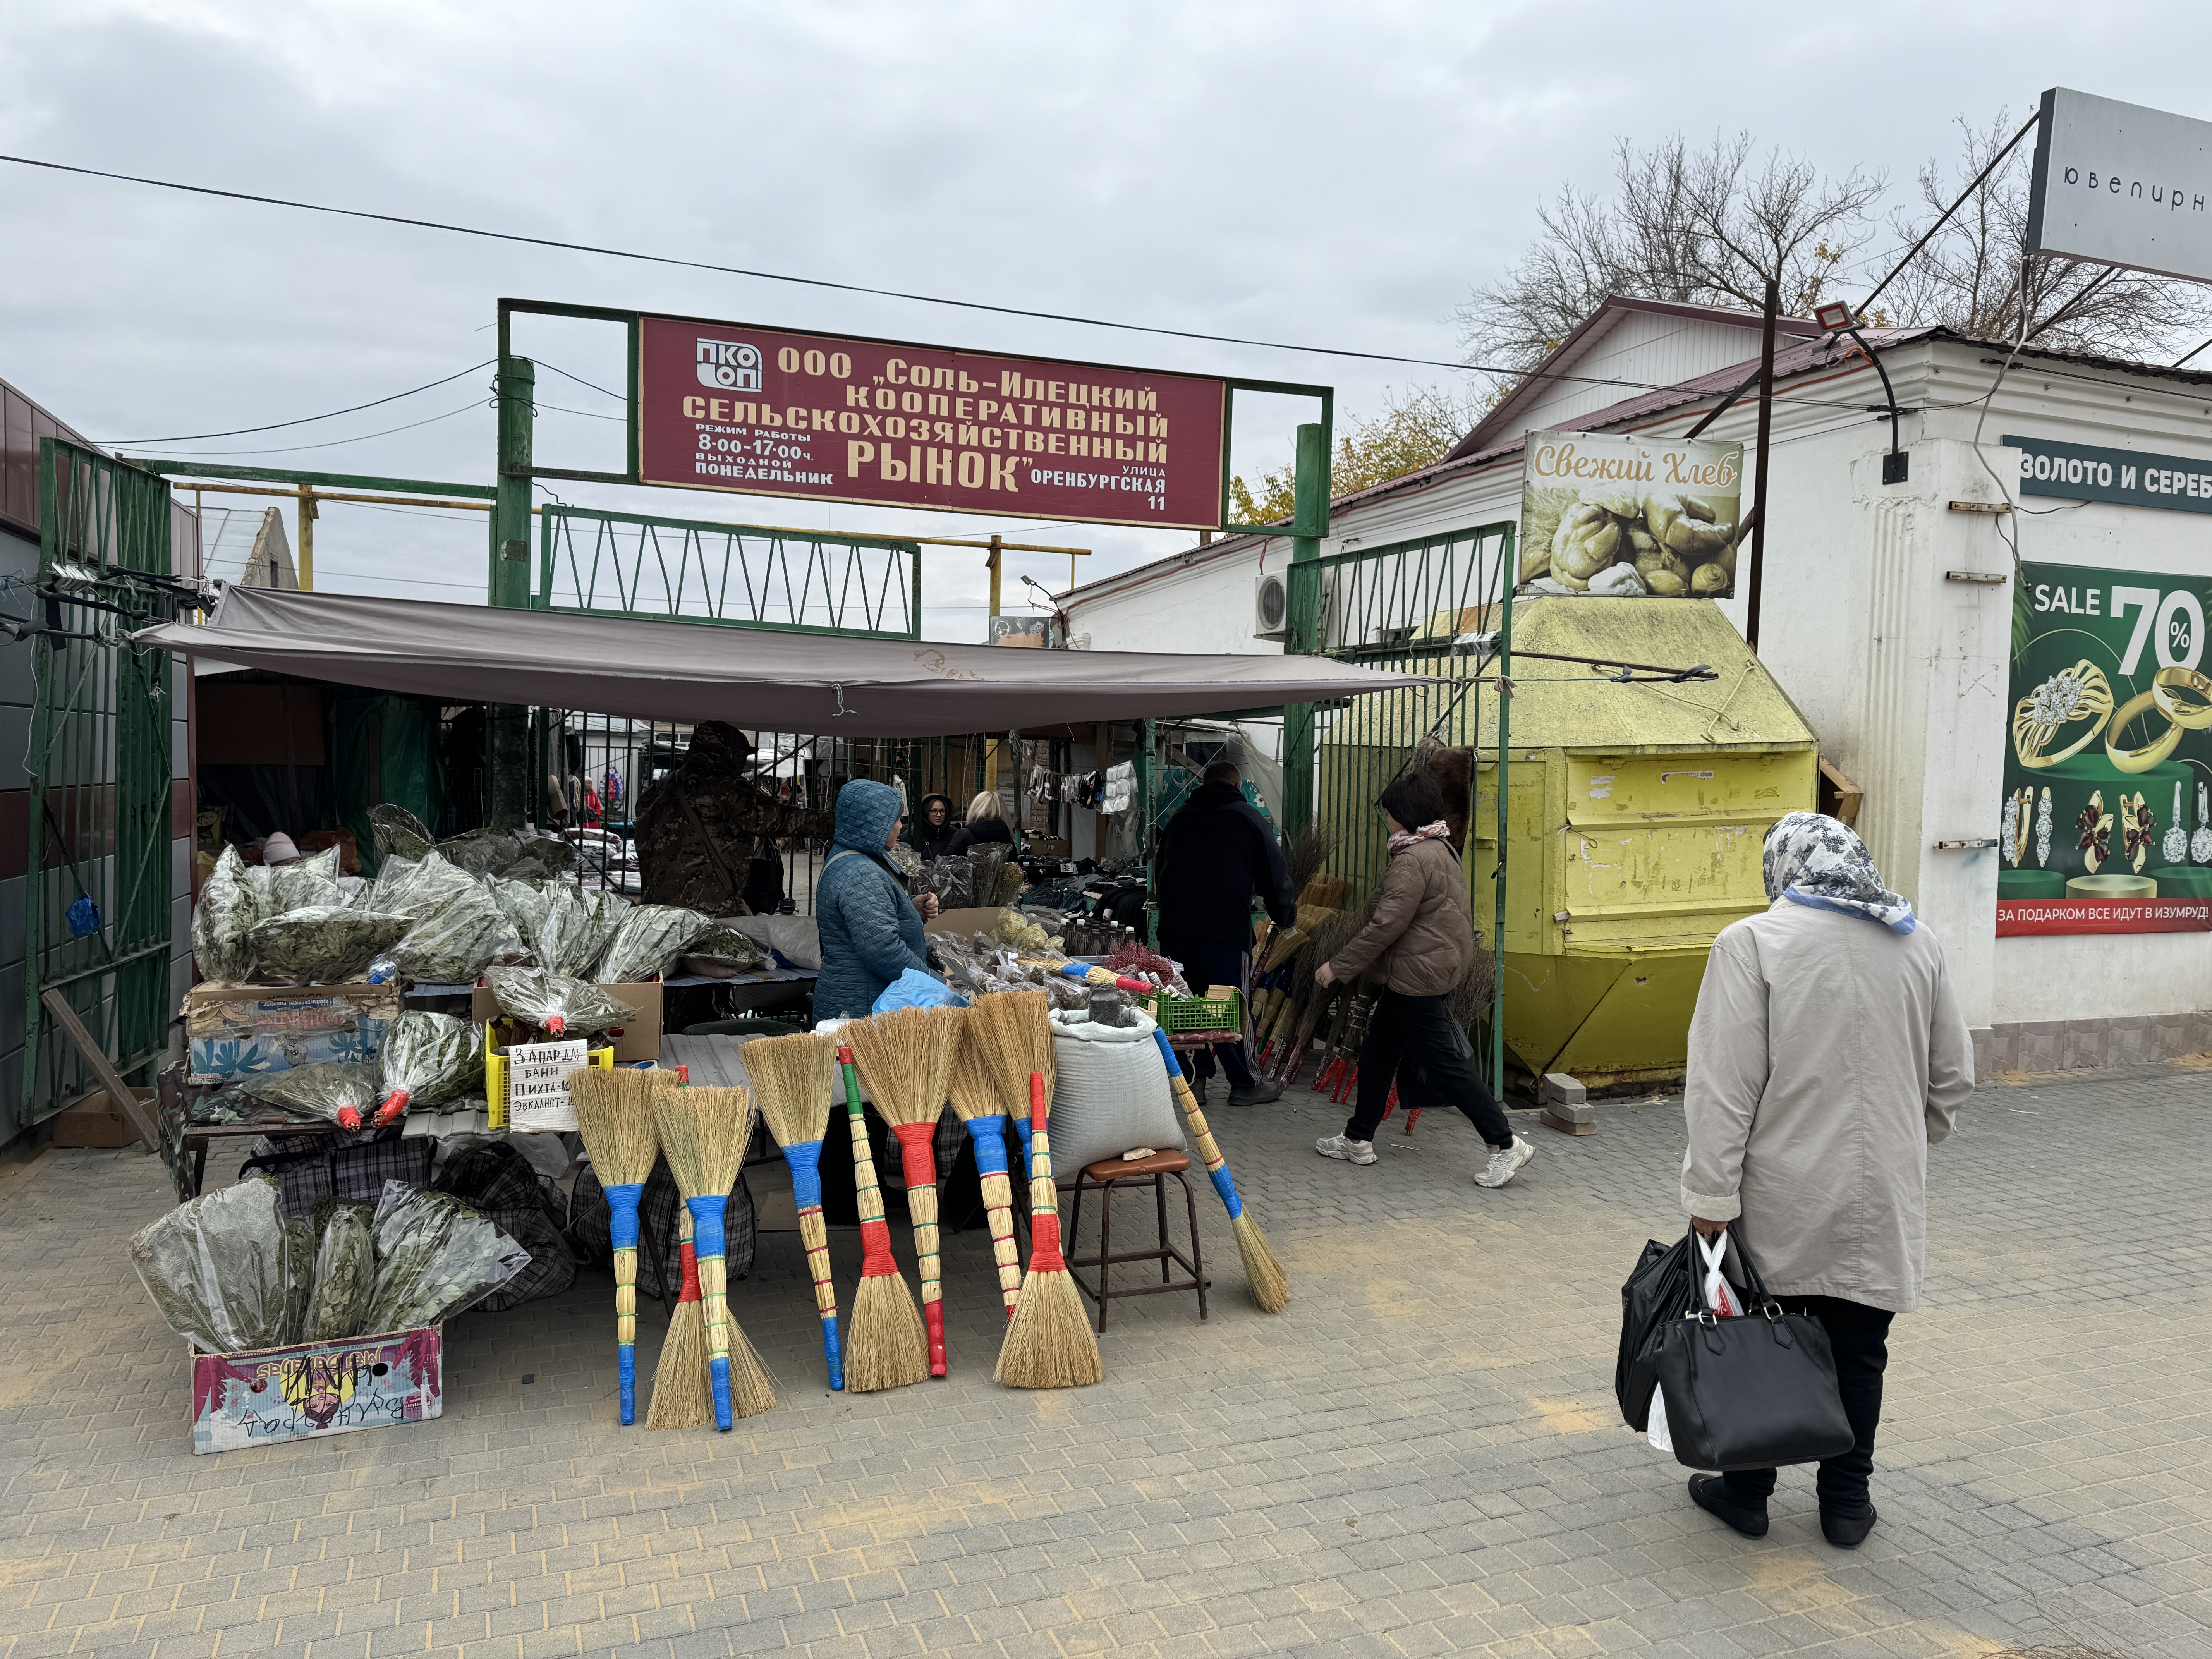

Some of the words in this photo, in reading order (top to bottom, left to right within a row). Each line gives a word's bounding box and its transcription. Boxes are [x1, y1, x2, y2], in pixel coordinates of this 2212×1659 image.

[778, 347, 851, 378] ООО
[847, 385, 1168, 438] КООПЕРАТИВНЫЙ
[683, 396, 1167, 464] СЕЛЬСКОХОЗЯЙСТВЕННЫЙ
[696, 423, 747, 435] РЕЖИМ
[754, 429, 811, 442] РАБОТЫ
[696, 452, 792, 468] ВЫХОДНОЙ
[1122, 465, 1166, 477] УЛИЦА
[1535, 443, 1655, 481] Свежий
[1664, 451, 1738, 486] Хлеб
[2021, 453, 2112, 487] ЗОЛОТО
[2121, 466, 2136, 489] И
[696, 462, 833, 485] ПОНЕДЕЛЬНИК
[1031, 469, 1165, 494] ОРЕНБУРГСКАЯ
[1148, 495, 1164, 510] 11
[2034, 584, 2101, 615] SALE
[1998, 909, 2014, 921] ЗА
[2018, 908, 2085, 922] ПОДАРКОМ
[2088, 908, 2110, 920] ВСЕ
[2113, 907, 2143, 921] ИДУТ
[2145, 907, 2152, 919] В
[2155, 907, 2208, 920] ИЗУМРУД!
